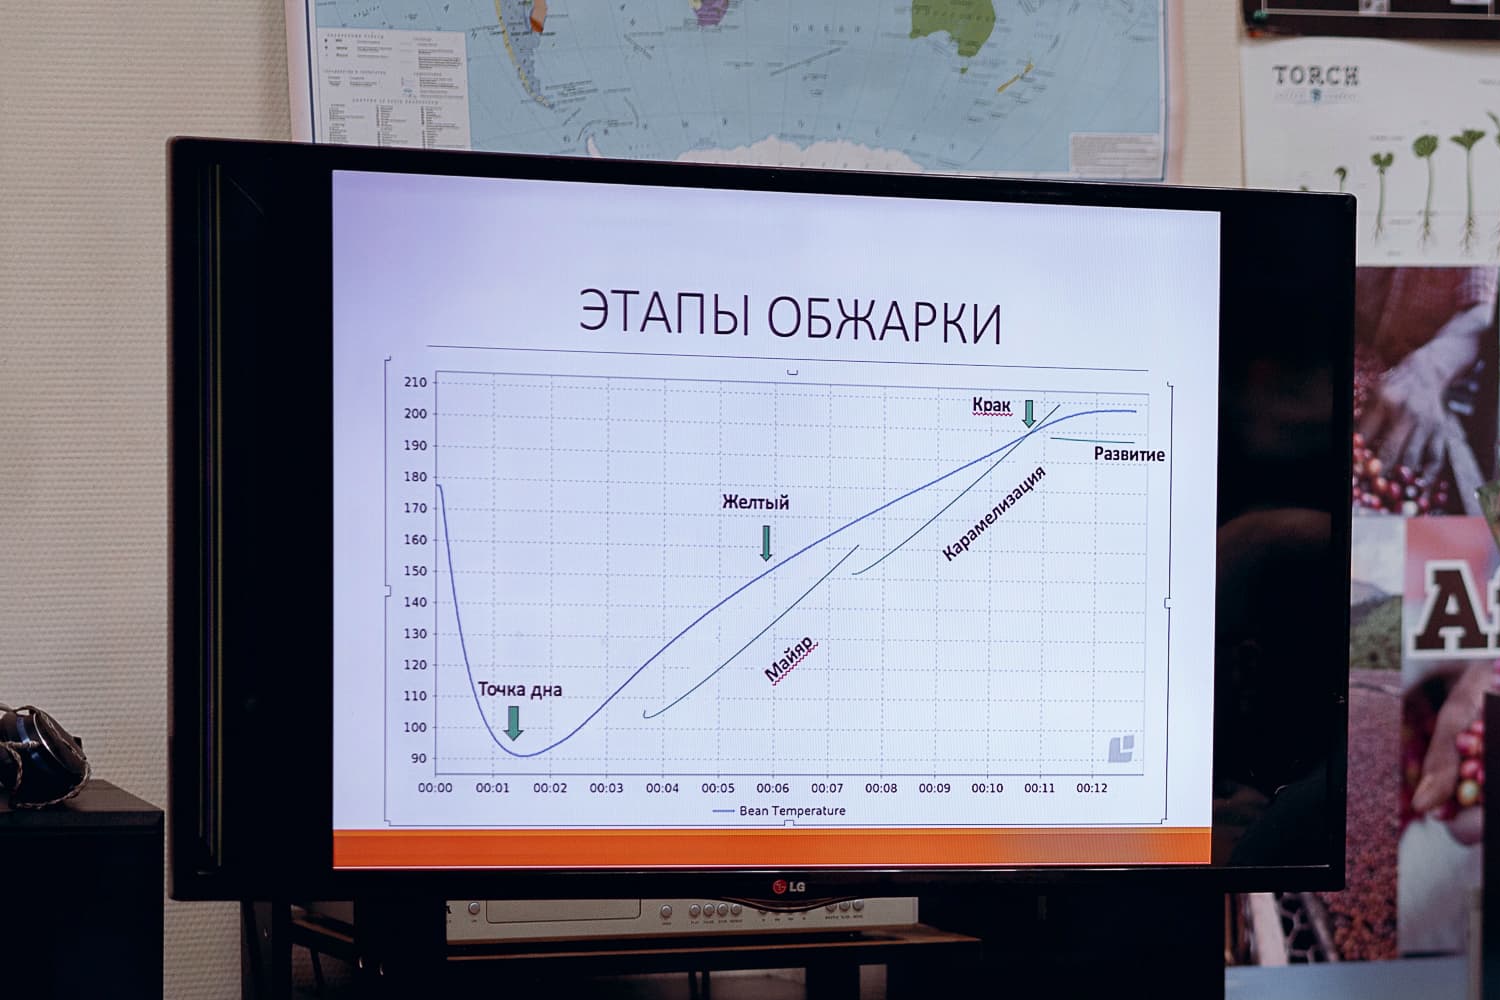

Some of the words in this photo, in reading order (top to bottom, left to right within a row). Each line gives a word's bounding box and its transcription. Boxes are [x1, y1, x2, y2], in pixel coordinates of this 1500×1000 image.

[1272, 64, 1360, 86] TORCH
[579, 287, 749, 337] ЭТАПЫ
[767, 295, 1002, 345] ОБЖАРКИ
[404, 377, 428, 387] 210
[972, 396, 1012, 412] Крак
[404, 409, 428, 419] 200
[404, 440, 428, 450] 190
[1094, 445, 1166, 462] Развитие
[404, 472, 428, 482] 180
[722, 493, 790, 511] Желтый
[404, 504, 428, 513] 170
[941, 465, 1047, 563] Карамелизация
[404, 535, 428, 545] 160
[404, 566, 428, 576] 150
[404, 597, 428, 607] 140
[404, 629, 428, 639] 130
[764, 635, 814, 683] Майяр
[404, 660, 428, 670] 120
[478, 681, 526, 697] Точка
[530, 684, 563, 700] дна
[404, 691, 428, 701] 110
[404, 722, 428, 732] 100
[411, 753, 428, 763] 90
[418, 783, 453, 794] 00:00
[475, 783, 510, 794] 00:01
[533, 783, 567, 794] 00:02
[589, 783, 624, 794] 00:03
[646, 783, 679, 794] 00:04
[701, 783, 735, 794] 00:05
[756, 783, 790, 794] 00:06
[811, 783, 843, 794] 00:07
[865, 783, 898, 794] 00:08
[918, 783, 951, 794] 00:09
[971, 783, 1004, 794] 00:10
[1024, 783, 1055, 794] 00:11
[1076, 783, 1108, 794] 00:12
[739, 805, 769, 816] Bean
[773, 805, 846, 819] Temperature
[789, 882, 806, 892] LG
